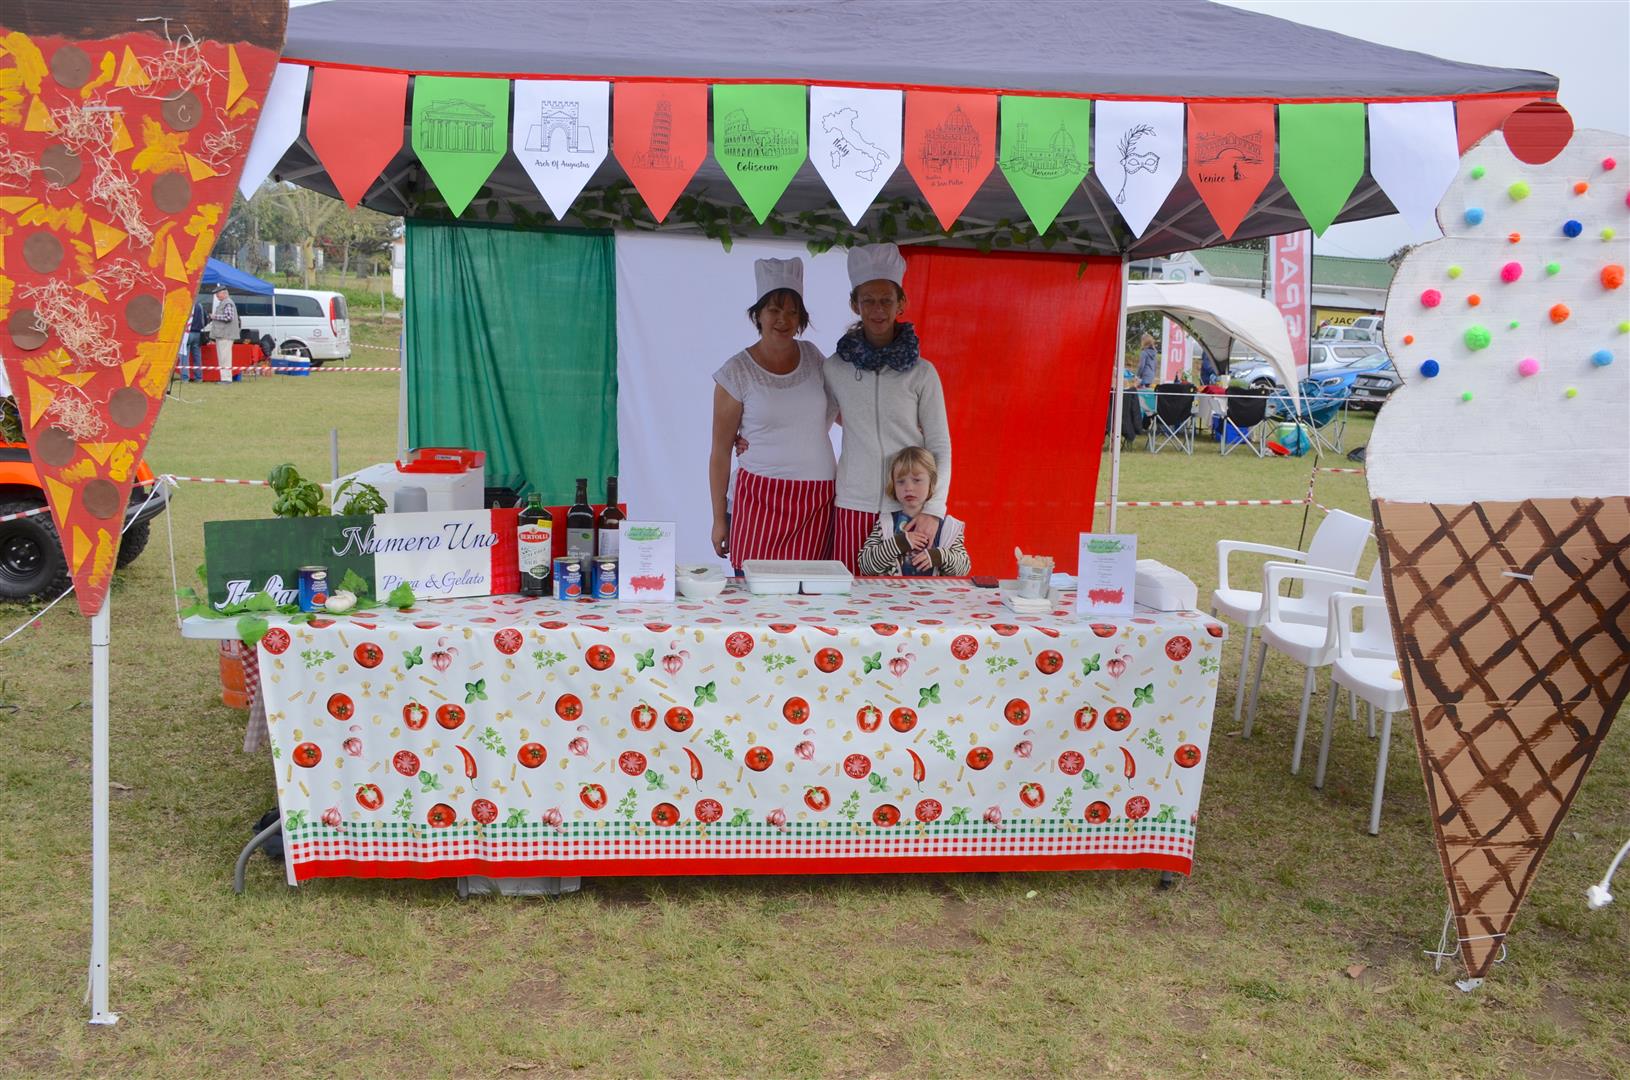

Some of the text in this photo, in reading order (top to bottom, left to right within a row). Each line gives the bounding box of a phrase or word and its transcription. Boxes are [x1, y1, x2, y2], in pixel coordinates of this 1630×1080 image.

[832, 138, 849, 157] Italy
[535, 159, 550, 168] Arch
[561, 159, 590, 169] Augustus
[736, 160, 779, 171] Coliseum
[1198, 172, 1225, 183] Venice
[332, 523, 499, 557] Numero Uno
[383, 569, 485, 594] Pia & Gelato
[214, 574, 299, 612] Itlia
